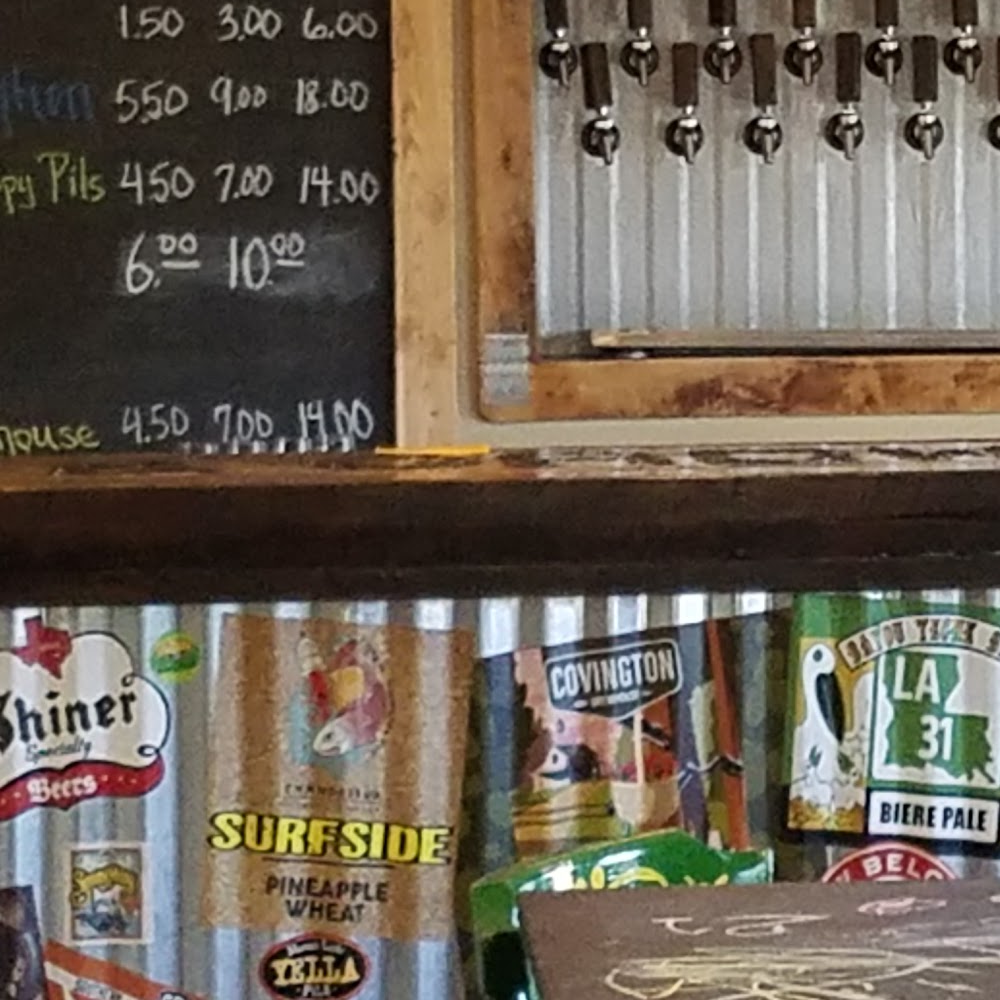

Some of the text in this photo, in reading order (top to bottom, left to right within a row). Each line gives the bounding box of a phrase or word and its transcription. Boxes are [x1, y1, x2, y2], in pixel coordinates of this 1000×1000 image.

[119, 3, 379, 41] 1.50 3.00 6.00
[210, 76, 268, 116] 9.00
[295, 78, 370, 115] 18.00
[37, 151, 106, 204] Pils
[214, 162, 274, 203] 7.00
[299, 164, 380, 207] 14.00
[121, 403, 190, 444] 4.50
[550, 649, 675, 700] COVINGTON
[892, 655, 941, 703] LA
[917, 713, 954, 762] 31
[26, 773, 98, 804] Beers
[879, 801, 987, 832] BIERE PALE
[209, 811, 454, 866] SURFSIDE
[265, 875, 389, 902] PINEAPPLE
[285, 899, 367, 924] WHEAT
[271, 955, 361, 988] YELLA
